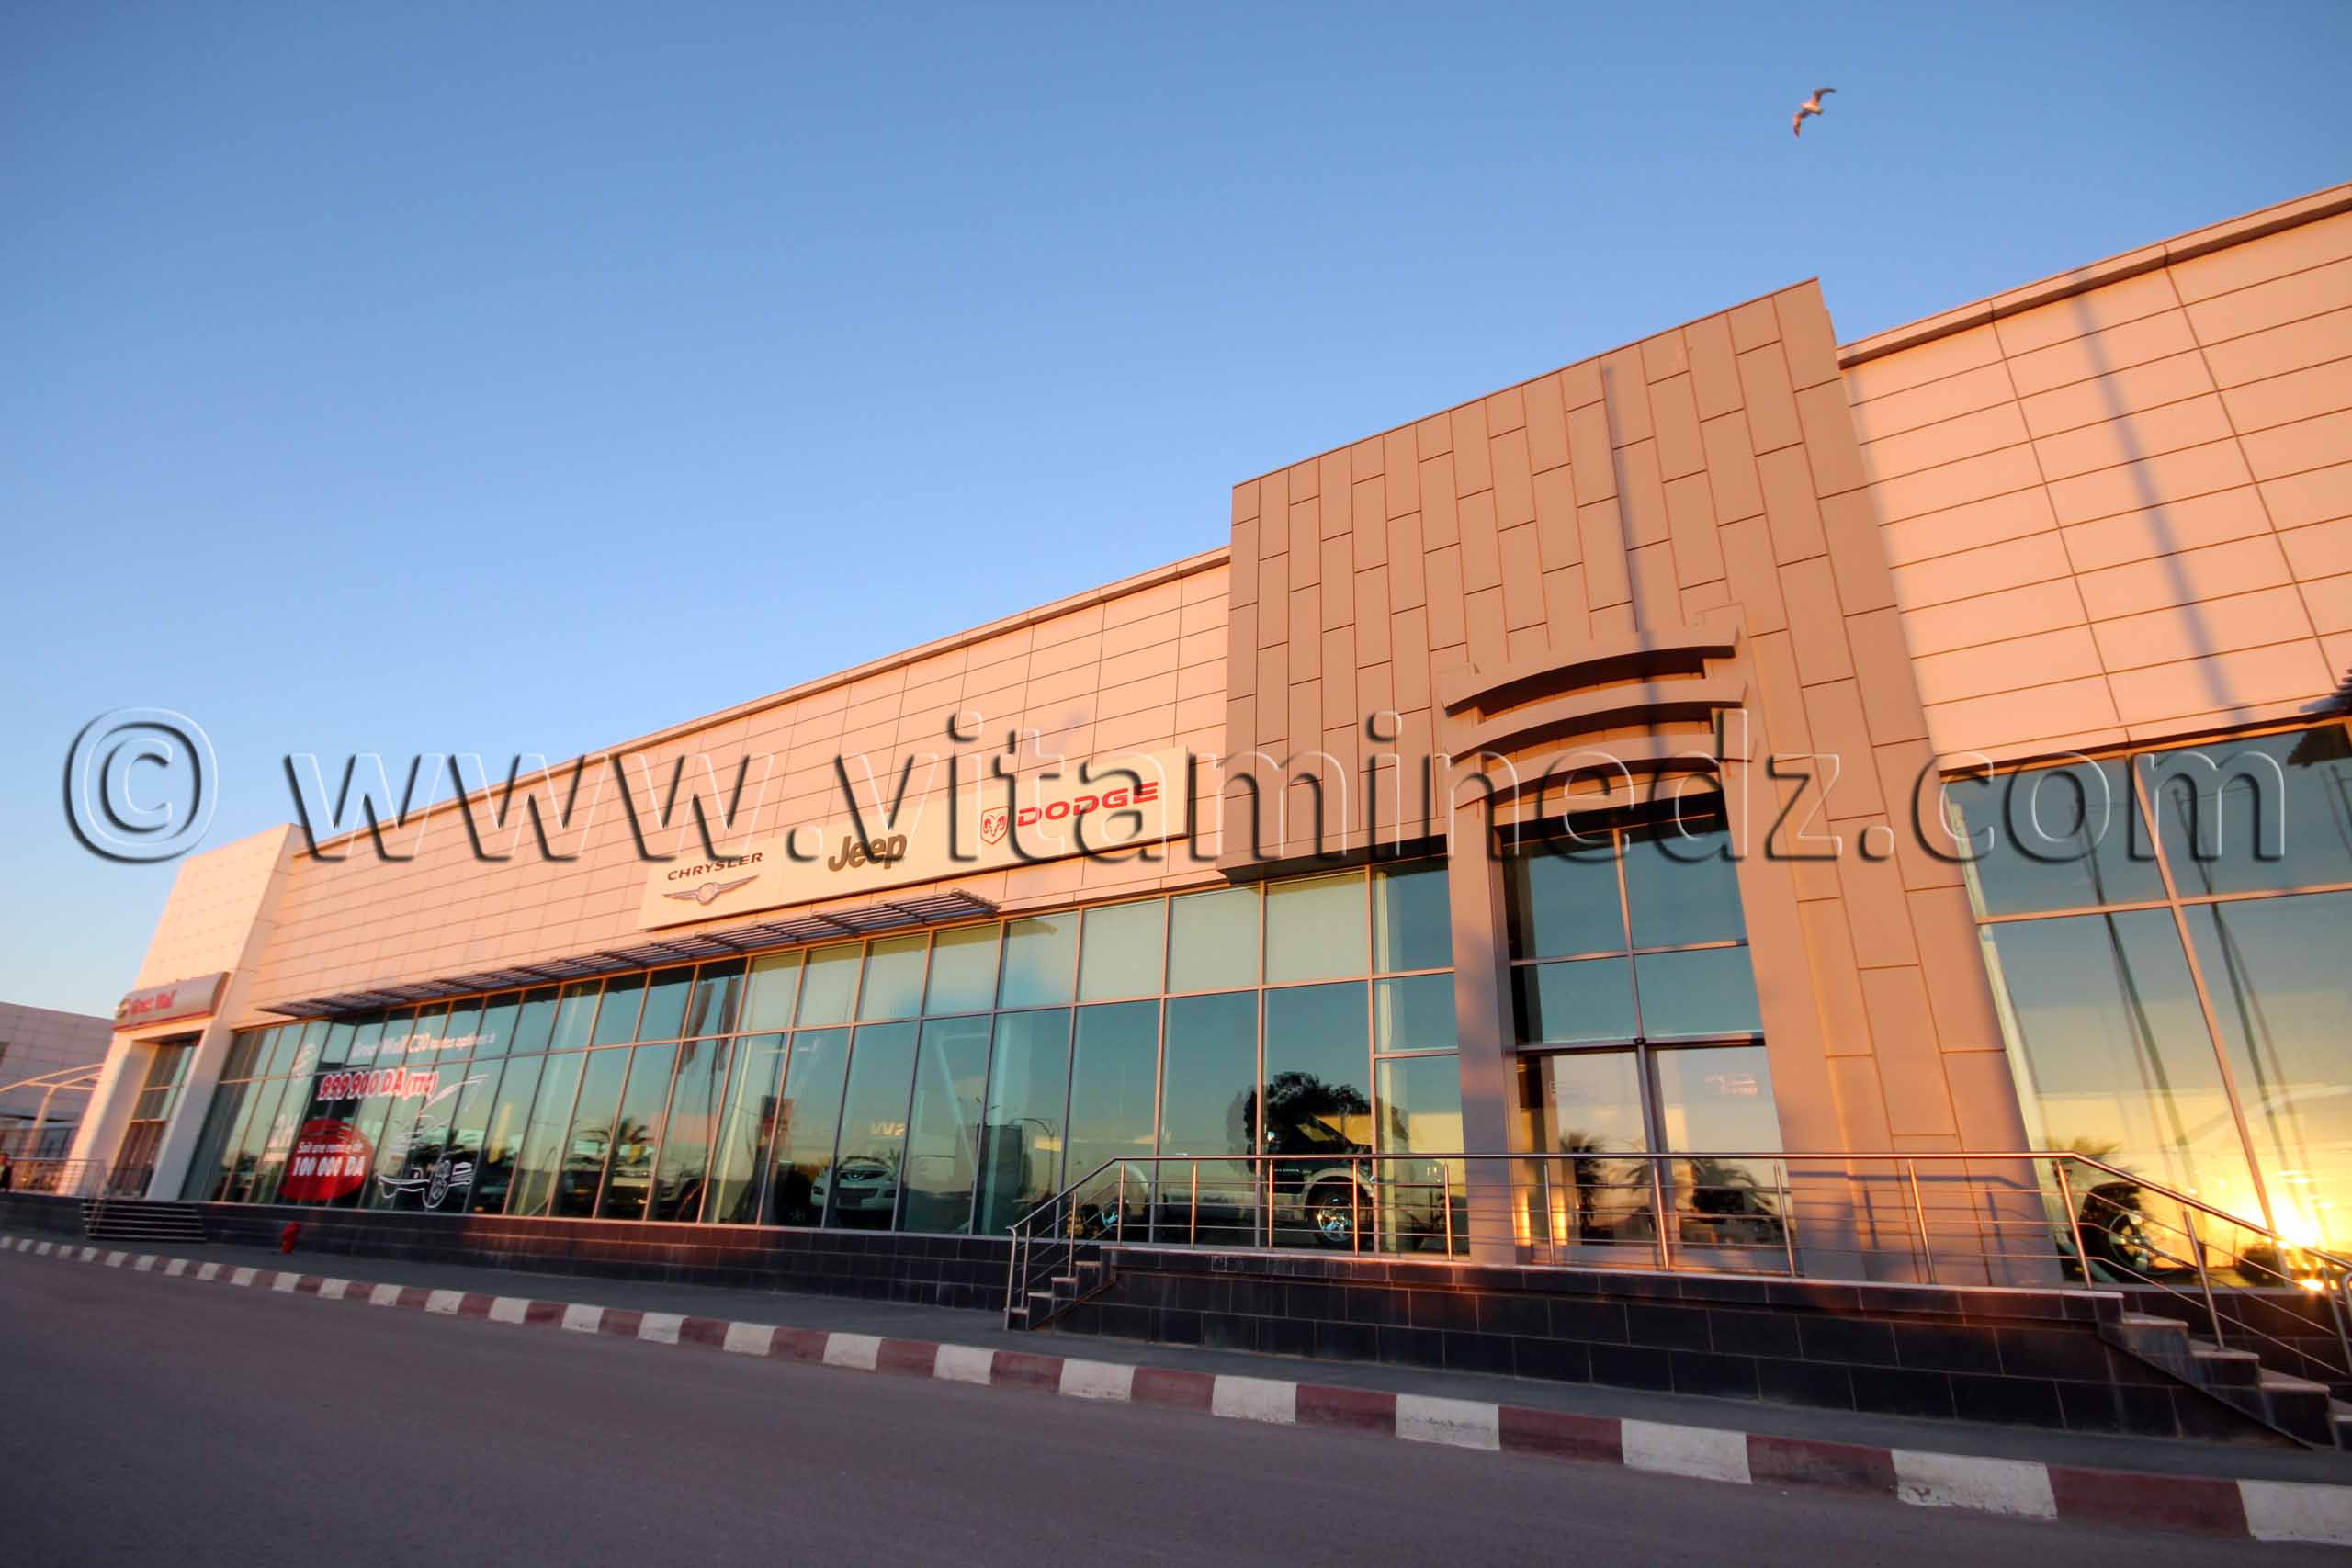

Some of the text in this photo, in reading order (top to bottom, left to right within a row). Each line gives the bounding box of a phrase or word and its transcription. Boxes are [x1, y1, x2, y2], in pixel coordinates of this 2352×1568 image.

[1016, 781, 1159, 827] DODGE
[667, 852, 764, 881] CHRYSLER
[828, 833, 908, 872] Jeep
[318, 1074, 351, 1100] 999
[347, 1070, 380, 1099] 900
[380, 1066, 407, 1095] DA
[292, 1156, 367, 1177] 100 000 DA
